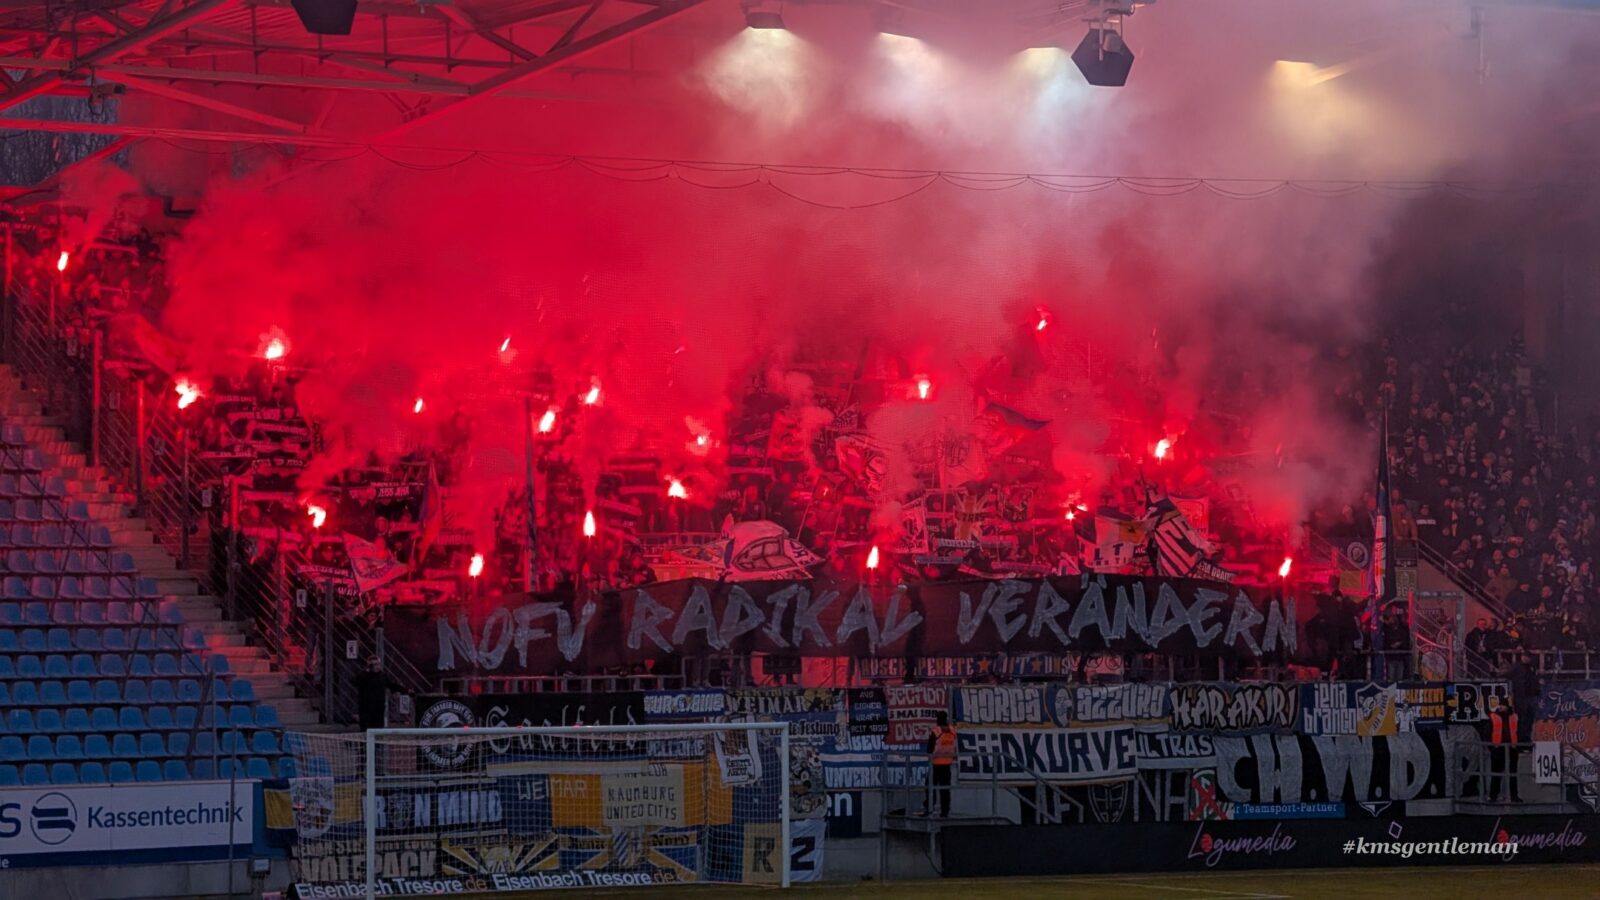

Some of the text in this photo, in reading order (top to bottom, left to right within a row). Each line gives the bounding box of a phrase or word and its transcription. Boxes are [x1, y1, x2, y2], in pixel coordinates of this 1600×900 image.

[437, 573, 1298, 671] NOFV RADIKAL VERÄNDERN
[861, 656, 975, 677] AUSGEPERRTE
[1170, 683, 1297, 729] HARAKIRI
[1303, 707, 1357, 734] branco
[957, 727, 1137, 774] SÜDKURVE
[1536, 754, 1560, 778] 19A
[607, 785, 675, 802] NAUMBURG
[87, 801, 244, 829] Kassentechnik
[606, 804, 644, 820] UNITED
[1242, 801, 1337, 815] Teamsport-Partner
[752, 837, 775, 873] R
[492, 870, 583, 891] Eisenbach
